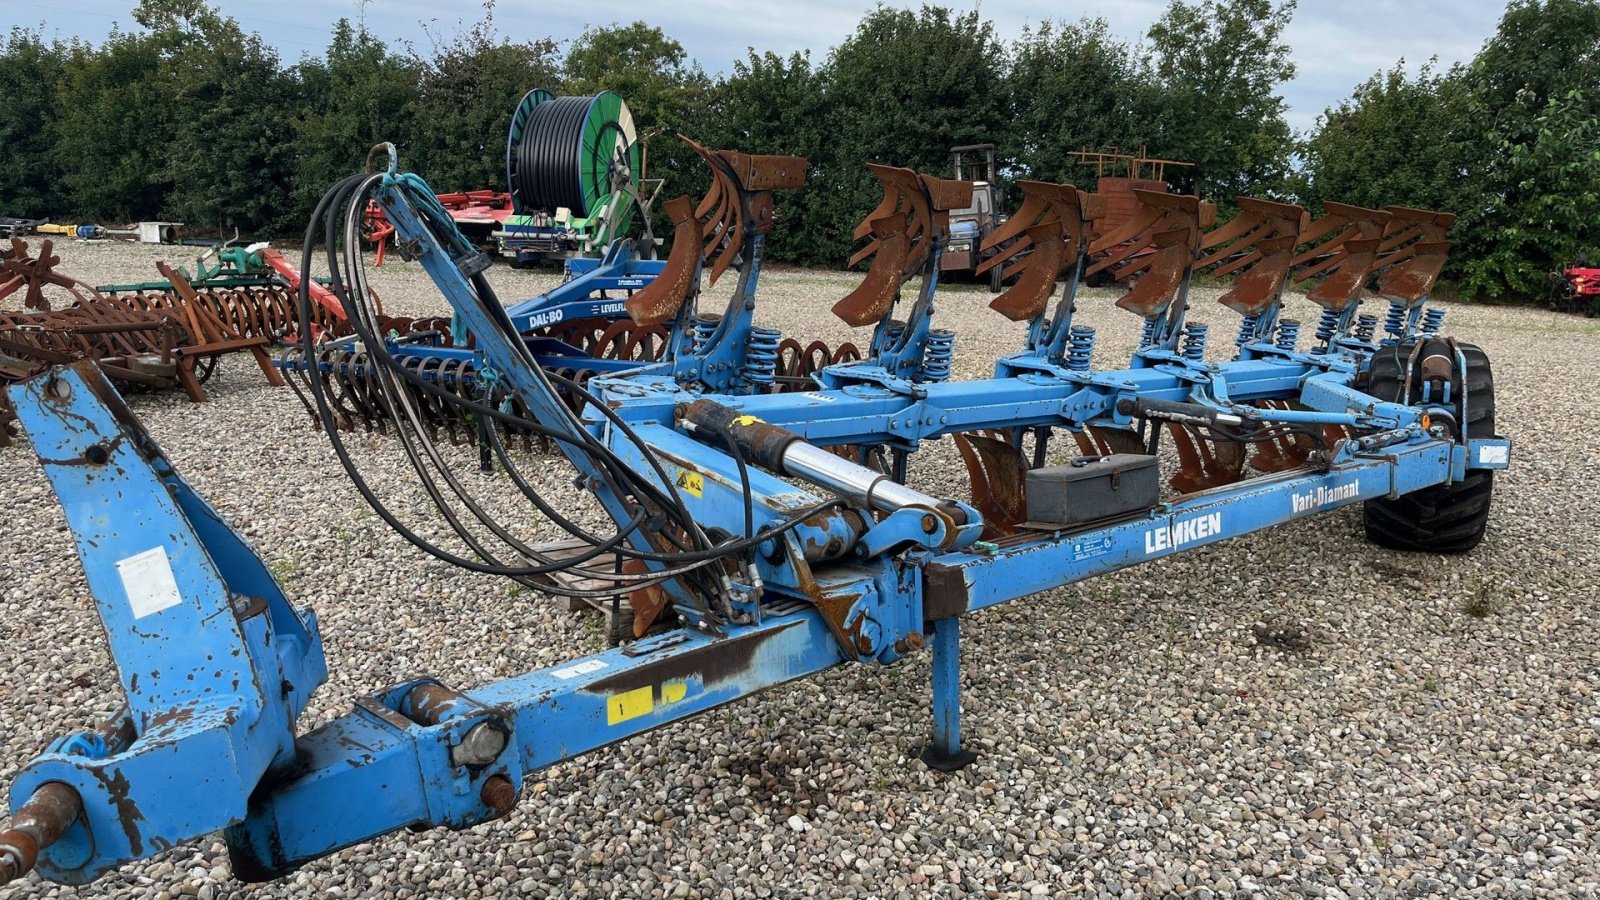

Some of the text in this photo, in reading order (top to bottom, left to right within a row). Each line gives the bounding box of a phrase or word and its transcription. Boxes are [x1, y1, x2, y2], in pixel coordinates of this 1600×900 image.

[601, 303, 627, 314] LEVELFL
[1292, 478, 1360, 513] Vari-Diamant
[1145, 511, 1221, 554] LEMKEN
